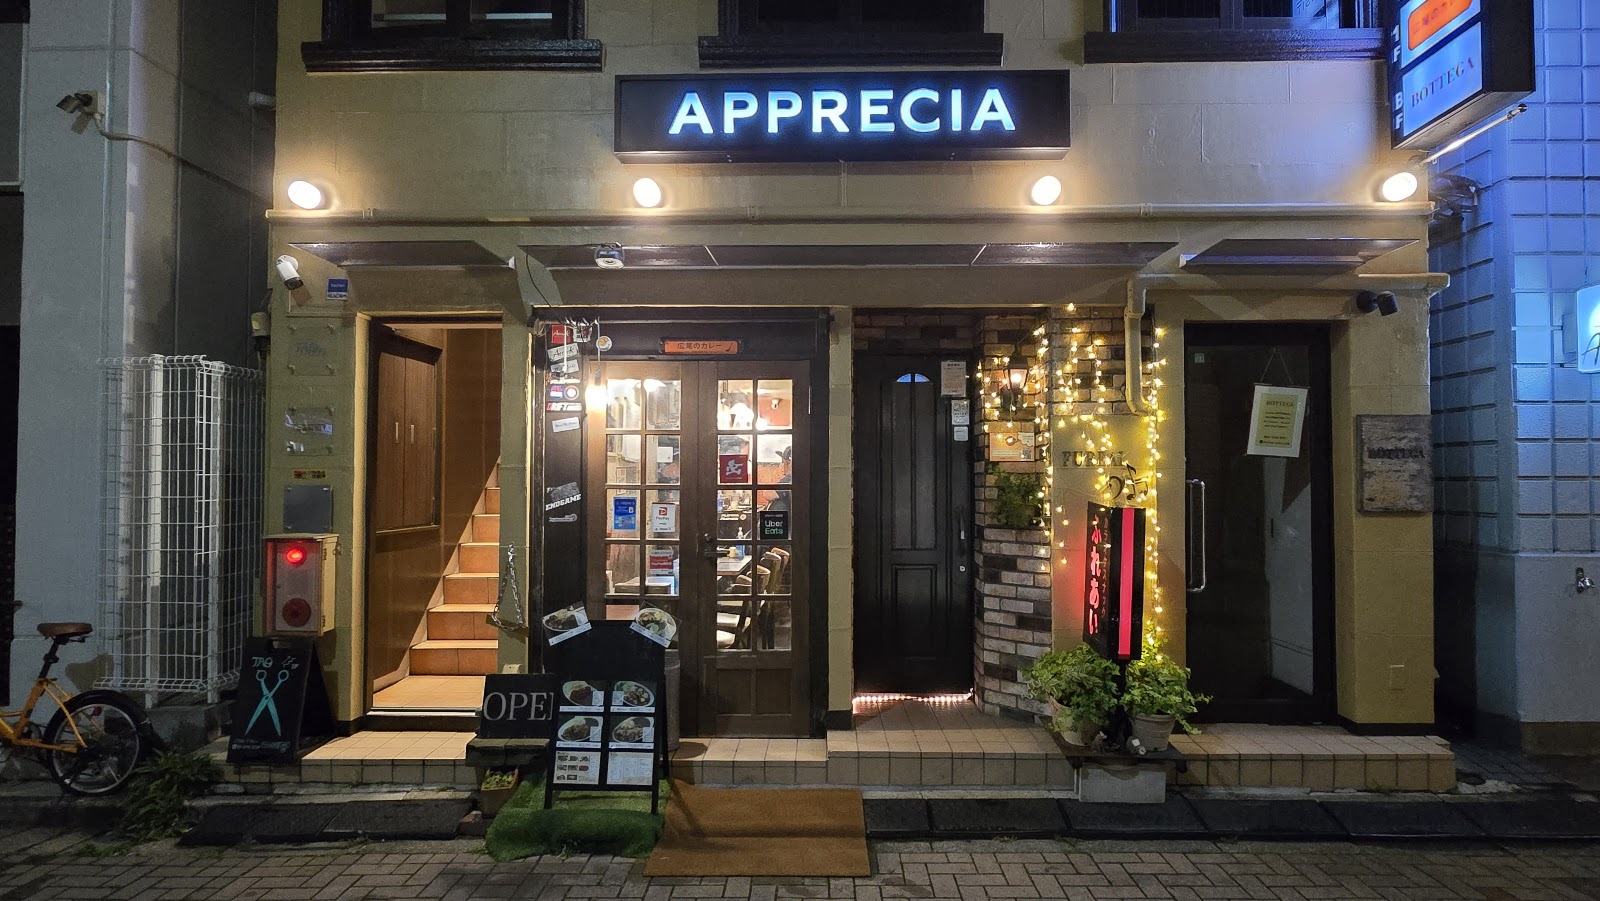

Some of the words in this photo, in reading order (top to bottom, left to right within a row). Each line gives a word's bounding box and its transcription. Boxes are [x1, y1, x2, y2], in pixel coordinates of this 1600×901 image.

[1411, 57, 1474, 108] BOTTEGA
[668, 88, 1016, 135] APPRECIA
[677, 342, 722, 350] 広尾のカレー
[1368, 446, 1425, 460] BOTTEGA
[545, 493, 582, 511] ENDGAME
